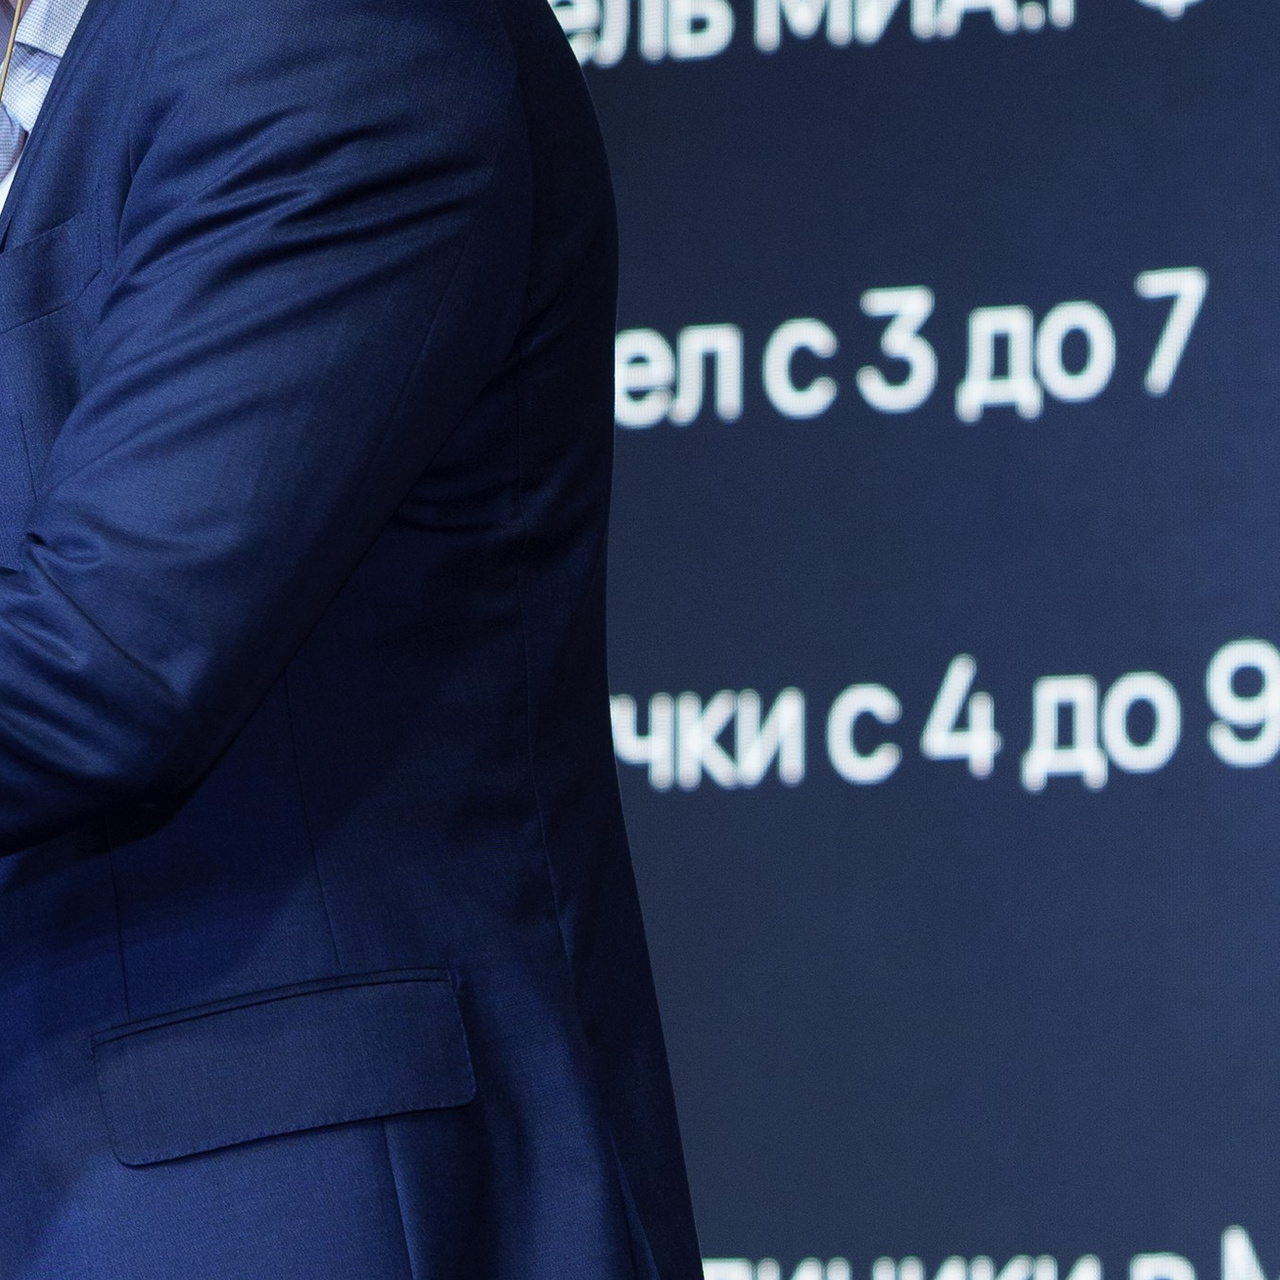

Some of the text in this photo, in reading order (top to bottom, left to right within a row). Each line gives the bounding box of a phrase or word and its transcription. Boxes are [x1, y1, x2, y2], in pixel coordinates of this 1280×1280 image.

[760, 315, 839, 421] с
[854, 283, 940, 415] 3
[953, 298, 1119, 425] до
[1134, 264, 1209, 397] 7
[824, 681, 902, 786] с
[919, 652, 1004, 779] 4
[1019, 669, 1184, 794] до
[1203, 636, 1280, 770] 9
